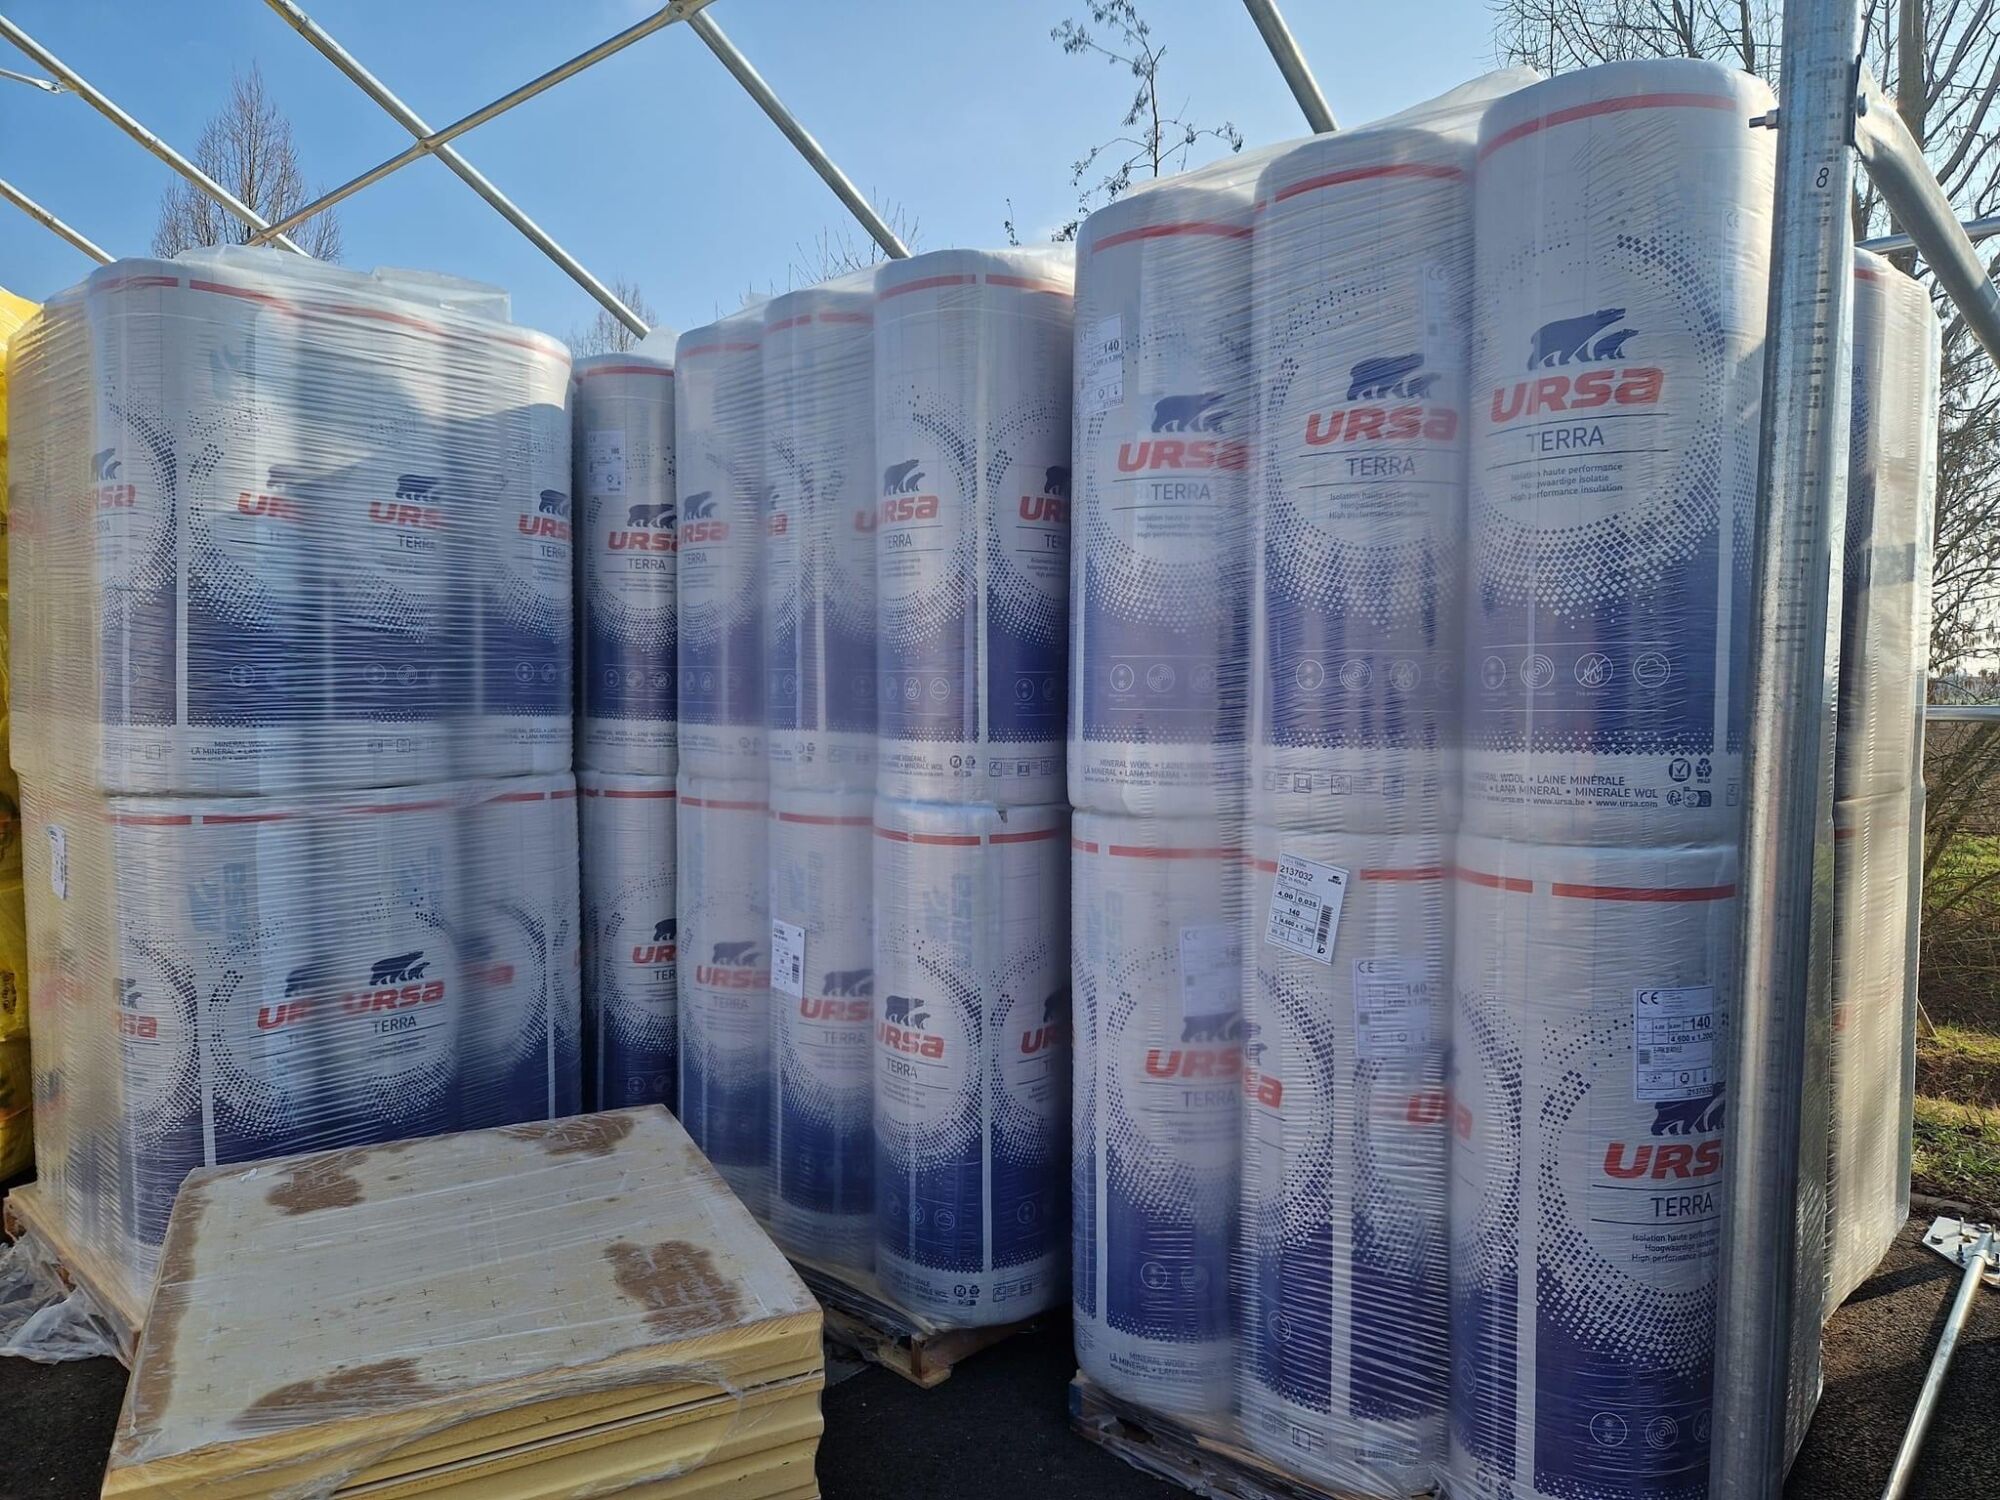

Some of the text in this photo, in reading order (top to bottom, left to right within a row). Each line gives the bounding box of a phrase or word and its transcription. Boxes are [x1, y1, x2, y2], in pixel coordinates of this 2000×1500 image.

[1815, 167, 1829, 188] 8
[1104, 339, 1119, 353] 140
[1526, 425, 1604, 452] TERRA
[1346, 456, 1416, 478] TERRA
[1152, 483, 1210, 501] TERRA
[628, 558, 666, 570] TERRA
[1500, 773, 1525, 783] WOOL
[1537, 774, 1566, 785] LAINE
[1519, 785, 1562, 796] MINERAL
[1575, 786, 1630, 798] MINERALE
[1634, 787, 1658, 799] WOL
[1279, 864, 1314, 882] 2137032
[1289, 908, 1300, 917] 140
[654, 970, 677, 980] TER
[372, 1015, 417, 1034] TERRA
[1691, 1015, 1711, 1030] 140
[823, 1030, 867, 1045] TERRA
[886, 1057, 918, 1080] TERRA
[1182, 1089, 1237, 1108] TERRA
[1650, 1193, 1713, 1218] TERRA
[1632, 1232, 1666, 1242] Isolation
